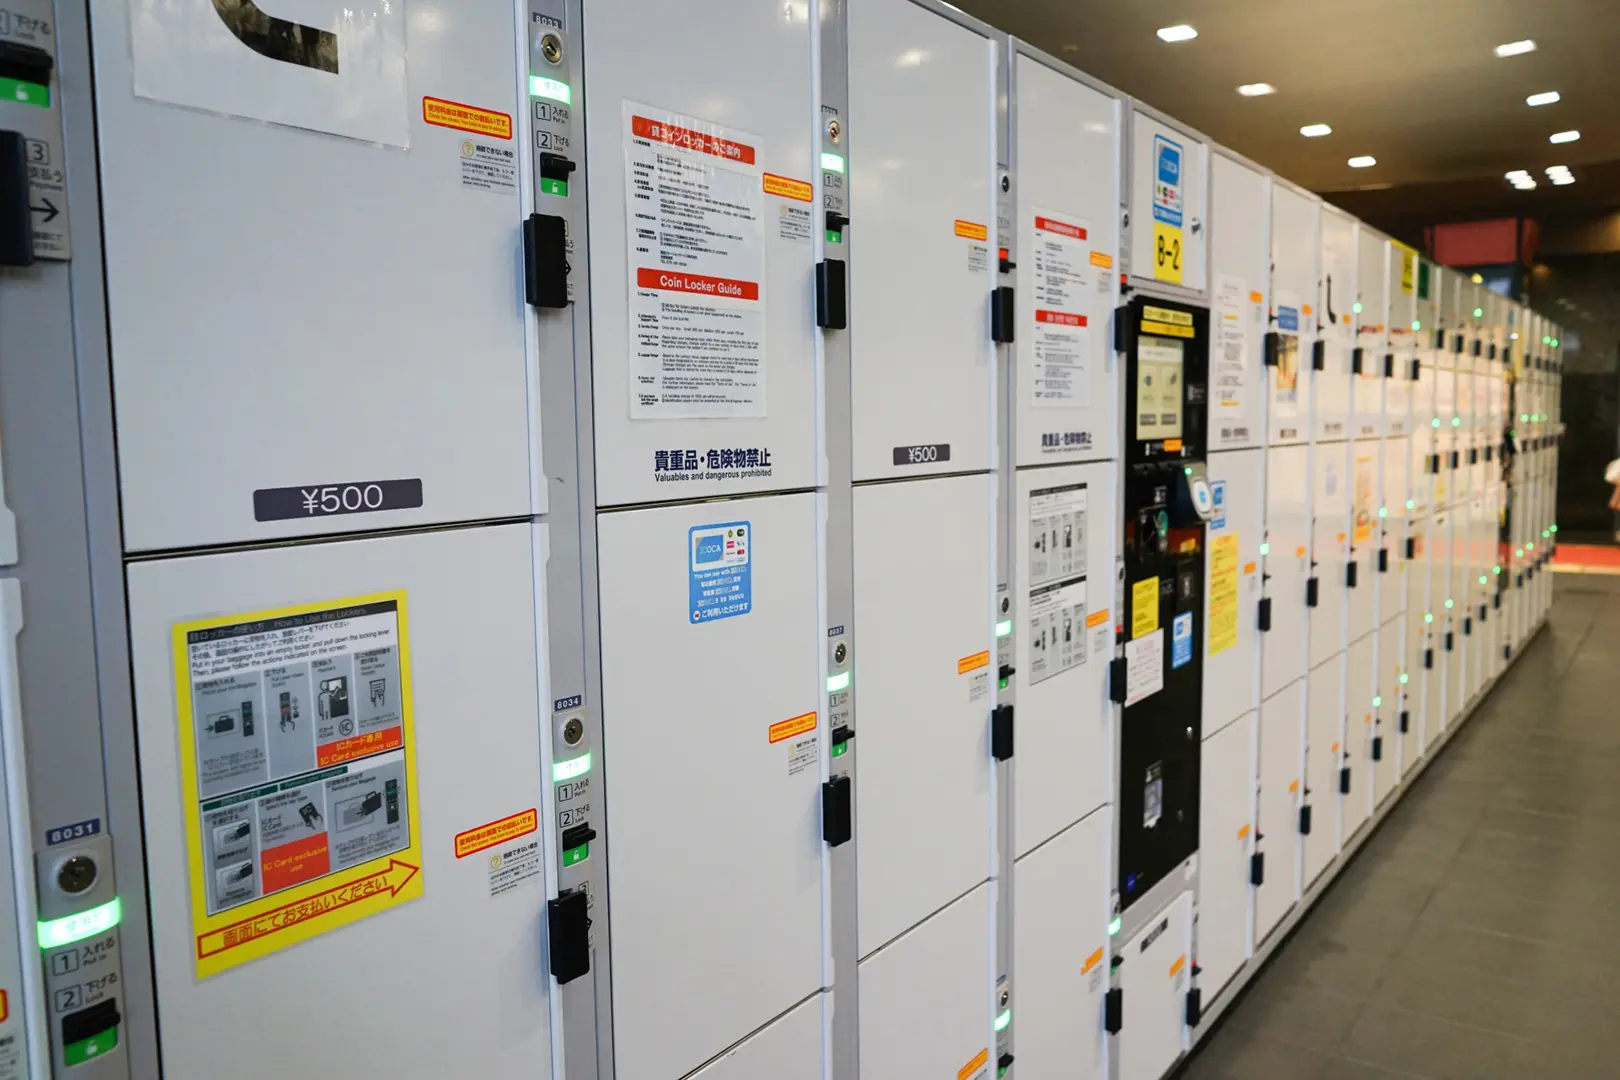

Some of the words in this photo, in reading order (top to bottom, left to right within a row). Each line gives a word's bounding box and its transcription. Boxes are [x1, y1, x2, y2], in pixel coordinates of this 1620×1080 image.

[536, 15, 558, 28] 8033
[554, 134, 570, 147] 下げる
[33, 144, 43, 160] 3
[660, 276, 682, 288] Coin
[685, 278, 715, 292] Locker
[718, 282, 742, 295] Guide
[654, 448, 771, 472] 貴重品・危険物禁止
[908, 446, 937, 462] ¥500
[655, 472, 689, 482] Valuables
[691, 472, 703, 480] and
[706, 471, 739, 480] dangerous
[741, 469, 771, 478] prohibited
[301, 484, 383, 514] ¥500
[275, 619, 293, 628] How
[336, 608, 366, 618] Lockers
[324, 638, 334, 646] pull
[360, 631, 376, 640] locking
[557, 698, 578, 709] 8034
[341, 722, 350, 732] IC
[336, 732, 382, 751] ICカード専用
[320, 757, 329, 765] IC
[332, 752, 349, 762] Card
[352, 743, 384, 756] exclusive
[386, 740, 398, 748] use
[575, 804, 590, 816] 下げる
[52, 823, 94, 843] 8031
[274, 857, 292, 867] Card
[294, 846, 327, 861] exclusive
[222, 877, 388, 948] 画面にてお支払いください
[83, 936, 115, 958] 入れる
[60, 955, 68, 970] 1
[85, 972, 117, 993] 下げる
[64, 991, 75, 1008] 2
